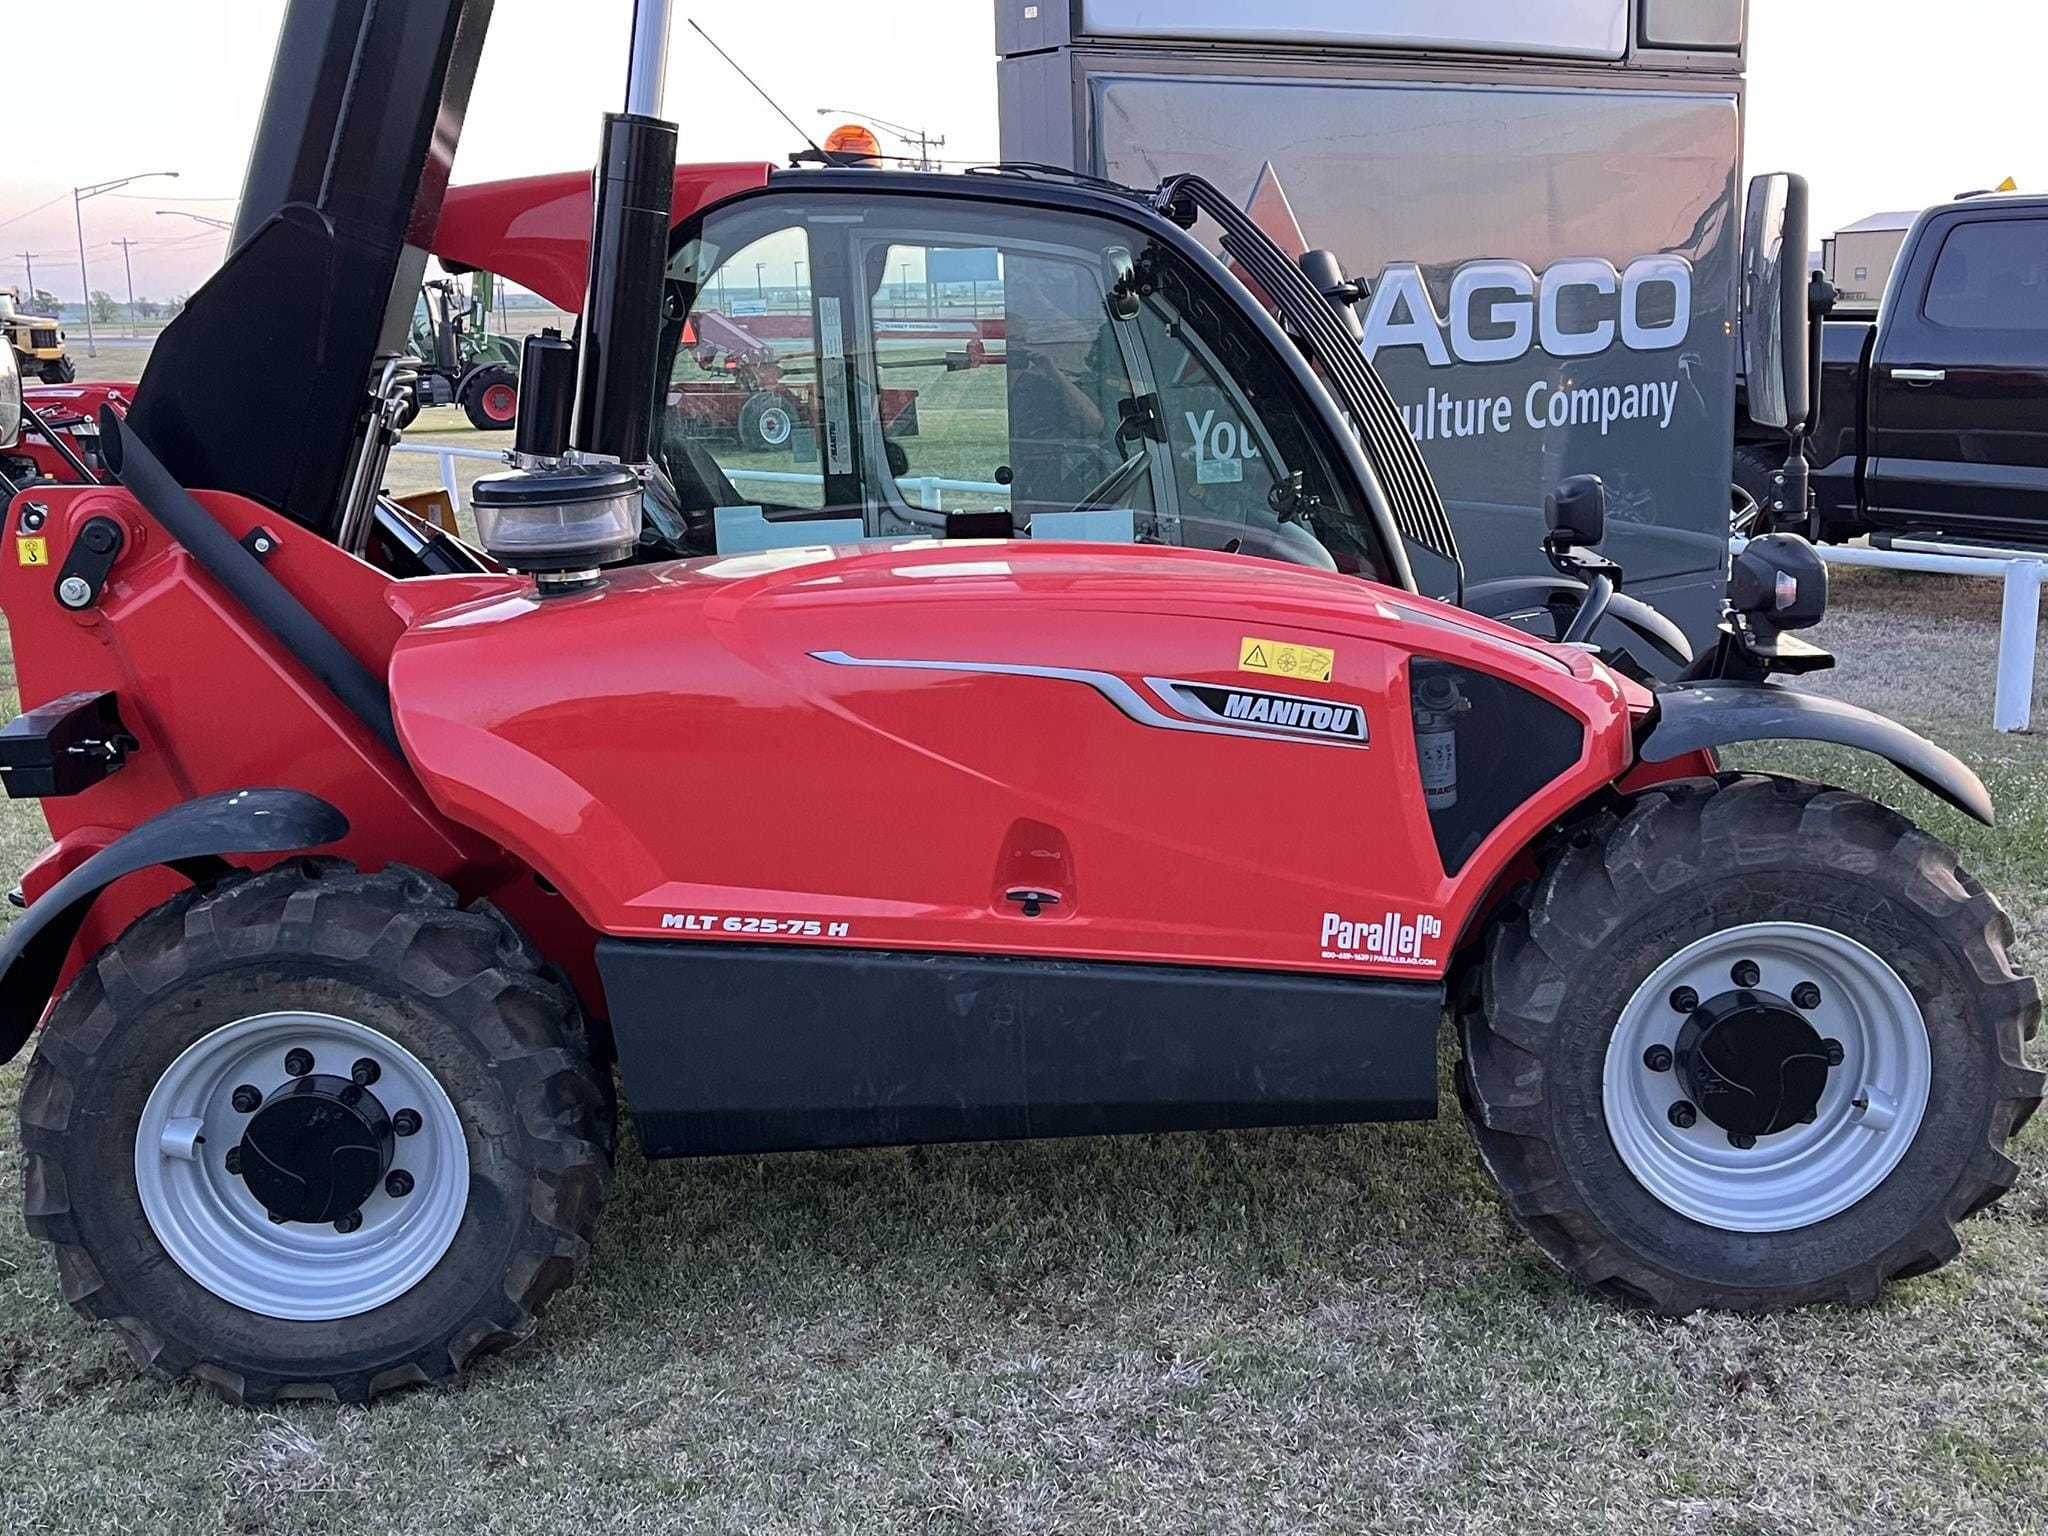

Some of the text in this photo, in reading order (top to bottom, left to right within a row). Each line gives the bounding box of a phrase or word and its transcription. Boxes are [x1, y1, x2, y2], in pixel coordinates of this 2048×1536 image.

[1359, 255, 1692, 366] AGCO
[1185, 409, 1262, 462] You
[1406, 386, 1511, 441] ulture
[1525, 380, 1679, 436] Company
[1224, 695, 1355, 732] MANITOU
[661, 913, 849, 937] MLT 625-75 H
[1321, 912, 1424, 958] Parallel
